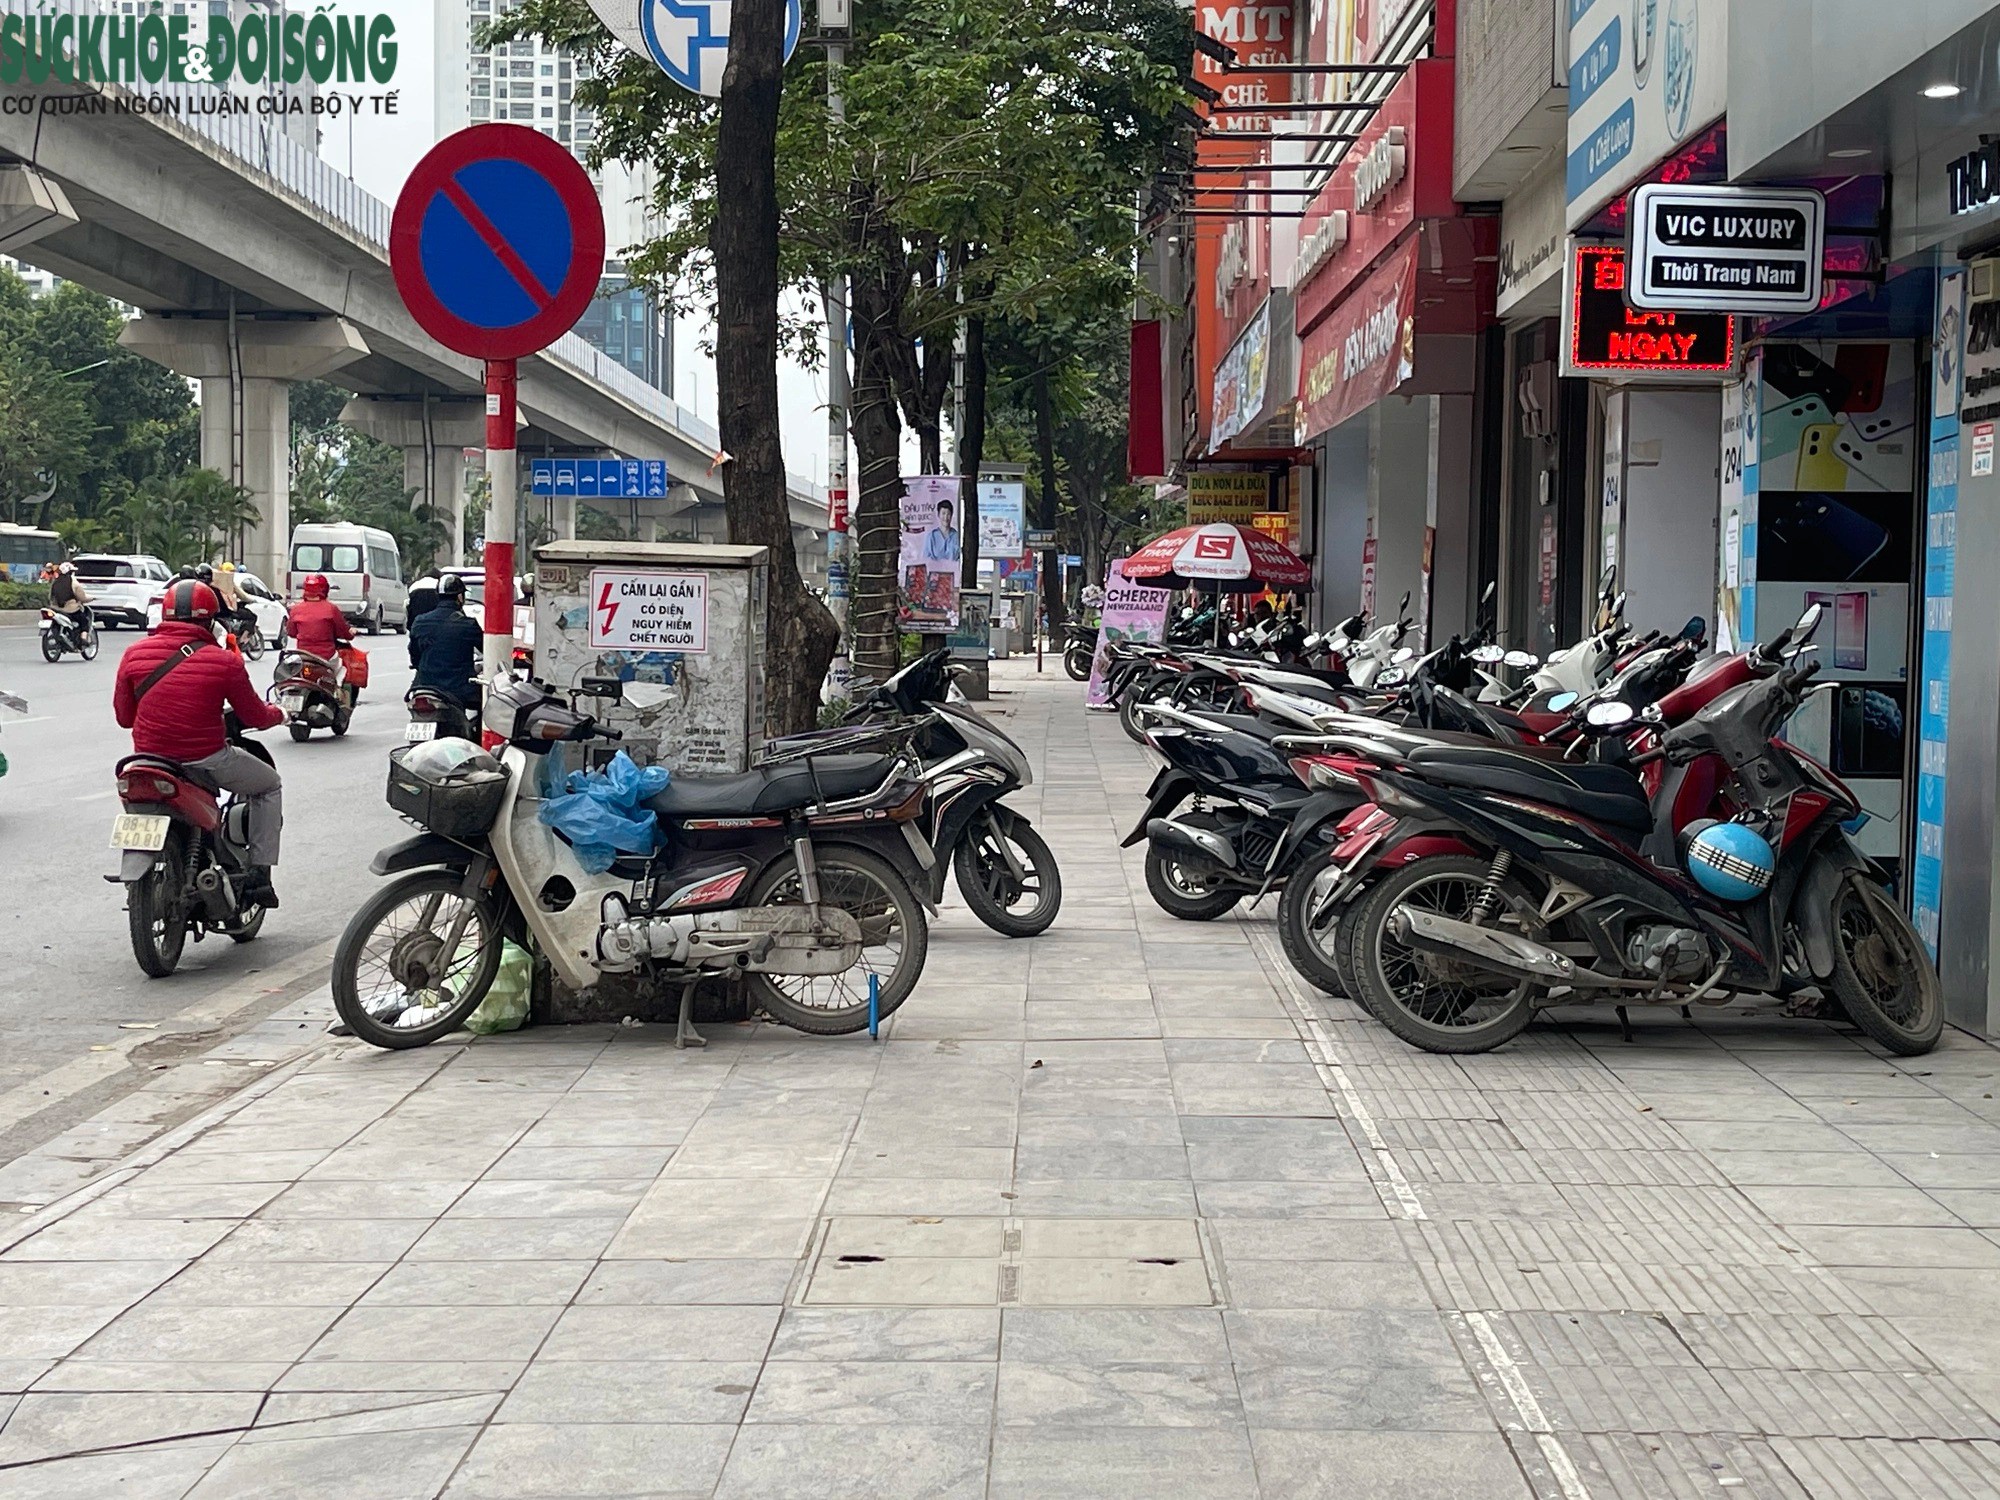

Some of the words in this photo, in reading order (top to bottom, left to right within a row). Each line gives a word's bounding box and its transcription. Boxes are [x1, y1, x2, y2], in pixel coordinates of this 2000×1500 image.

[1202, 0, 1291, 42] MÍT
[1223, 79, 1269, 105] CHÈ
[1666, 215, 1706, 236] VIC
[1713, 217, 1796, 239] LUXURY
[1662, 262, 1698, 282] Thời
[1704, 263, 1751, 285] Trang
[1756, 266, 1796, 285] Nam
[1609, 332, 1697, 360] NGAY
[1725, 447, 1742, 484] 294
[1256, 551, 1295, 566] TÍNH
[621, 578, 647, 596] CẤM
[649, 584, 667, 601] LẠI
[1107, 589, 1169, 603] CHERRY
[640, 603, 656, 615] CÓ
[1106, 602, 1164, 612] NEWZEALAND
[632, 619, 663, 629] NGUY
[665, 616, 692, 630] HIỂM
[629, 630, 658, 643] CHẾT
[659, 632, 694, 644] NGƯỜI
